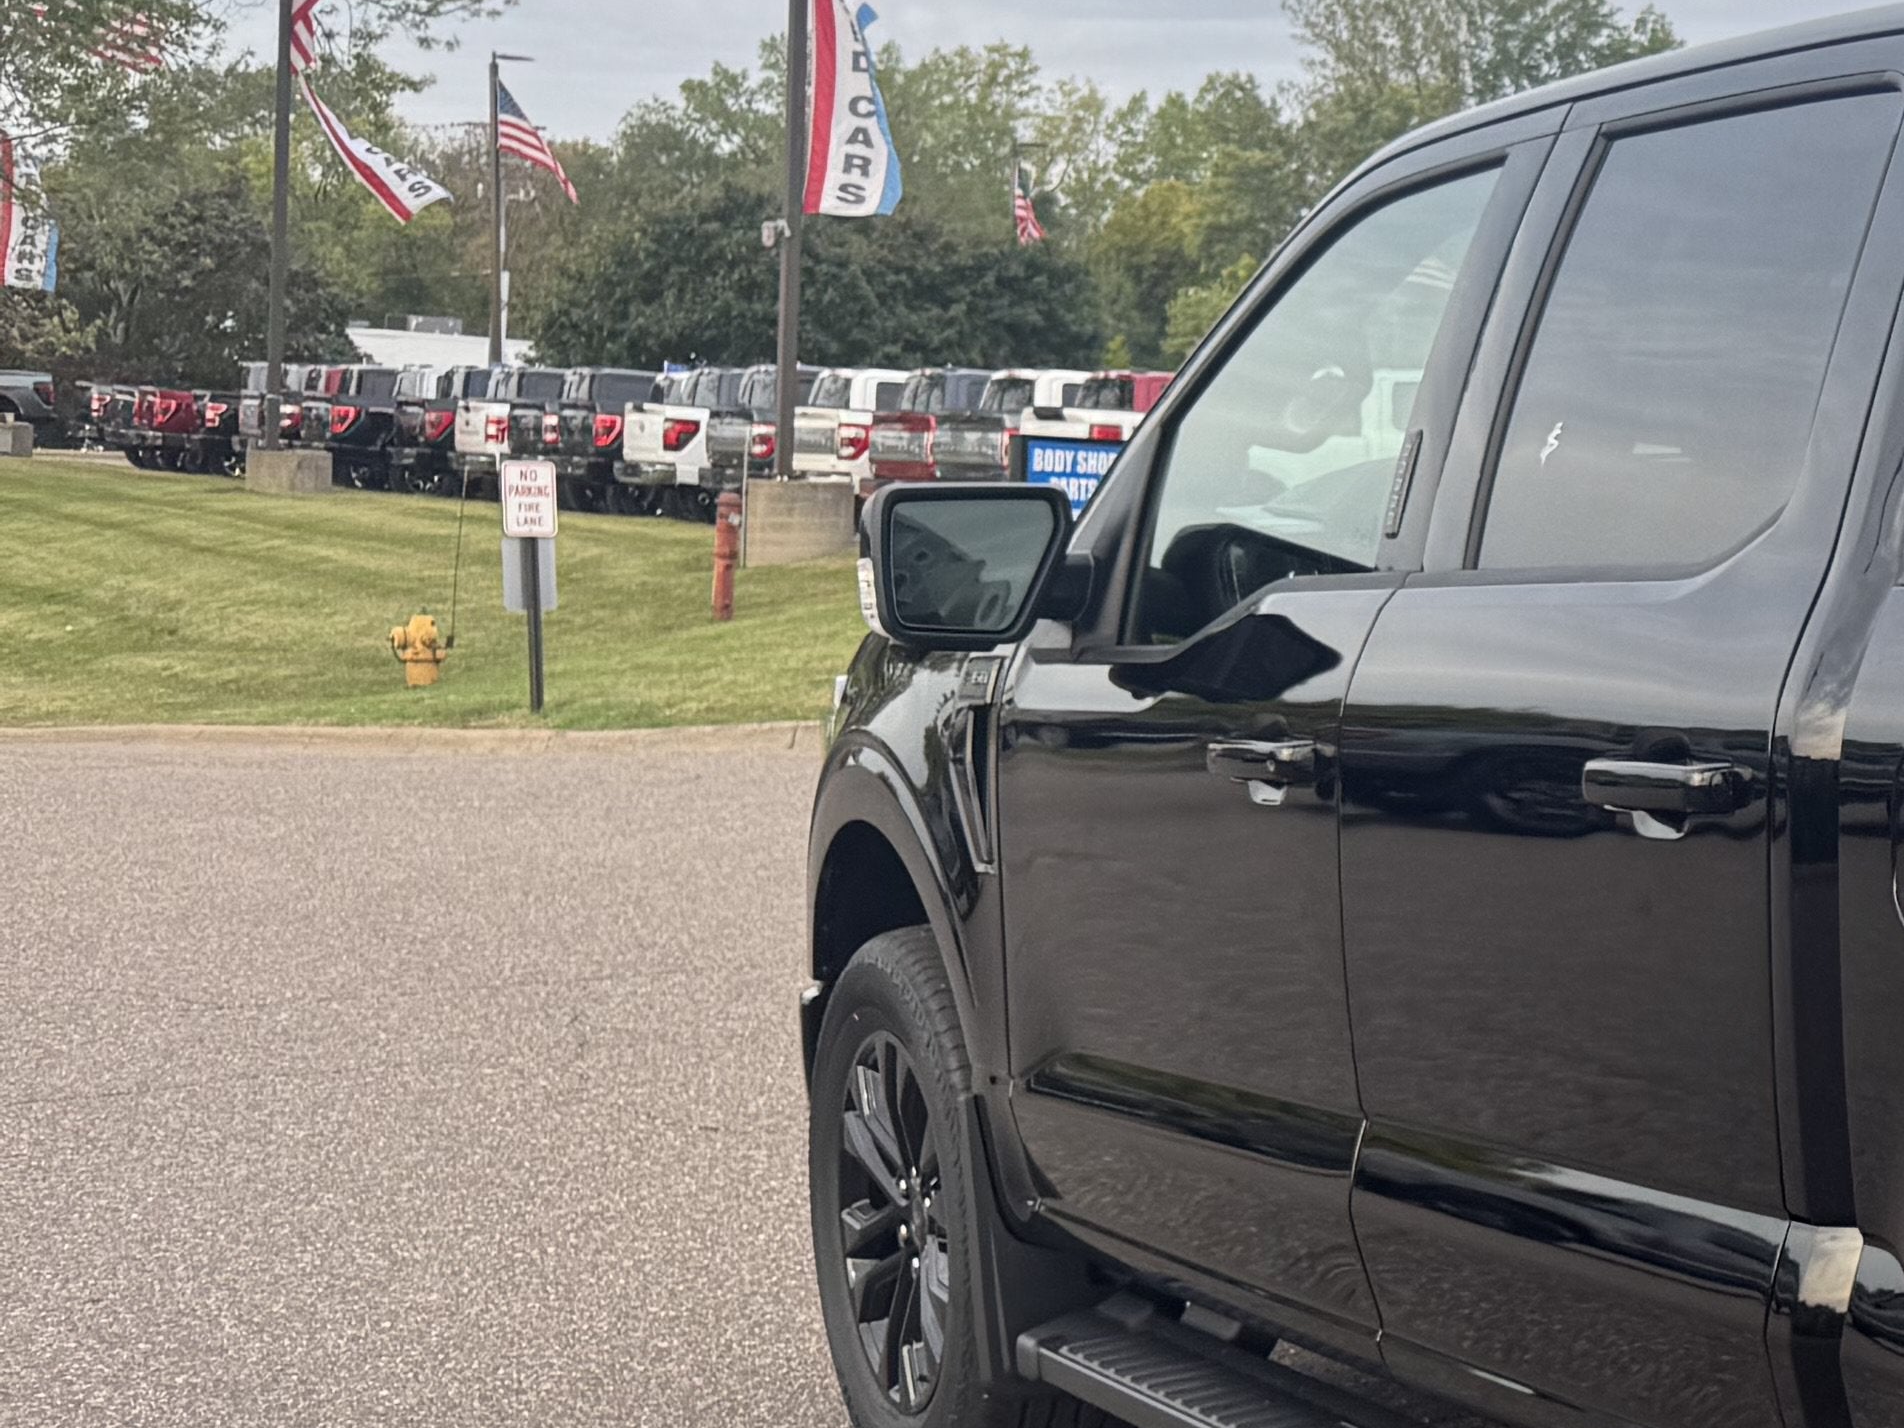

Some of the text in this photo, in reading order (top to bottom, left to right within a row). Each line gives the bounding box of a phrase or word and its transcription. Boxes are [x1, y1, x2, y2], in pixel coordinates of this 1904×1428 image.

[836, 95, 877, 205] CARS
[1033, 448, 1075, 472] BODY
[520, 469, 538, 482] NO
[508, 484, 550, 498] PARKING
[518, 502, 540, 513] FIRE
[516, 516, 545, 527] LANE
